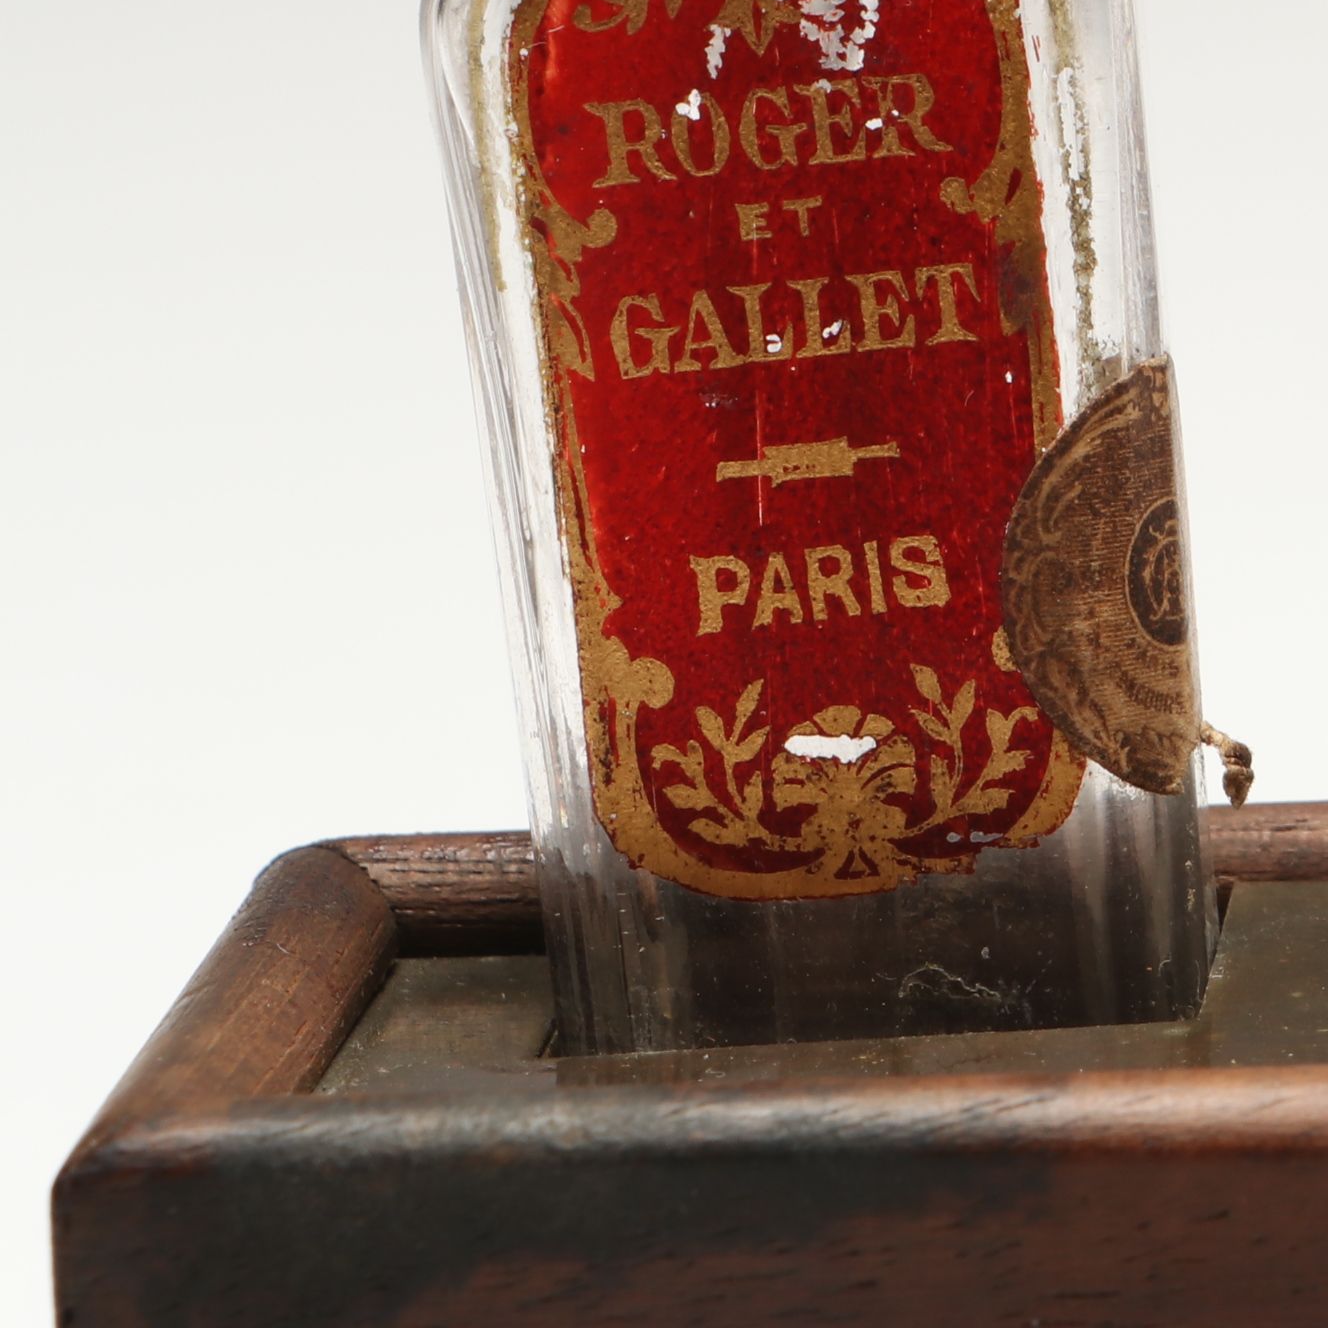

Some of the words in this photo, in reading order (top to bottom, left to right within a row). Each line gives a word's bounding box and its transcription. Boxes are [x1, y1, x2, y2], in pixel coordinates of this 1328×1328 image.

[580, 72, 955, 191] ROGER
[734, 194, 824, 242] ET
[609, 262, 982, 381] GALLET
[689, 534, 953, 638] PARIS
